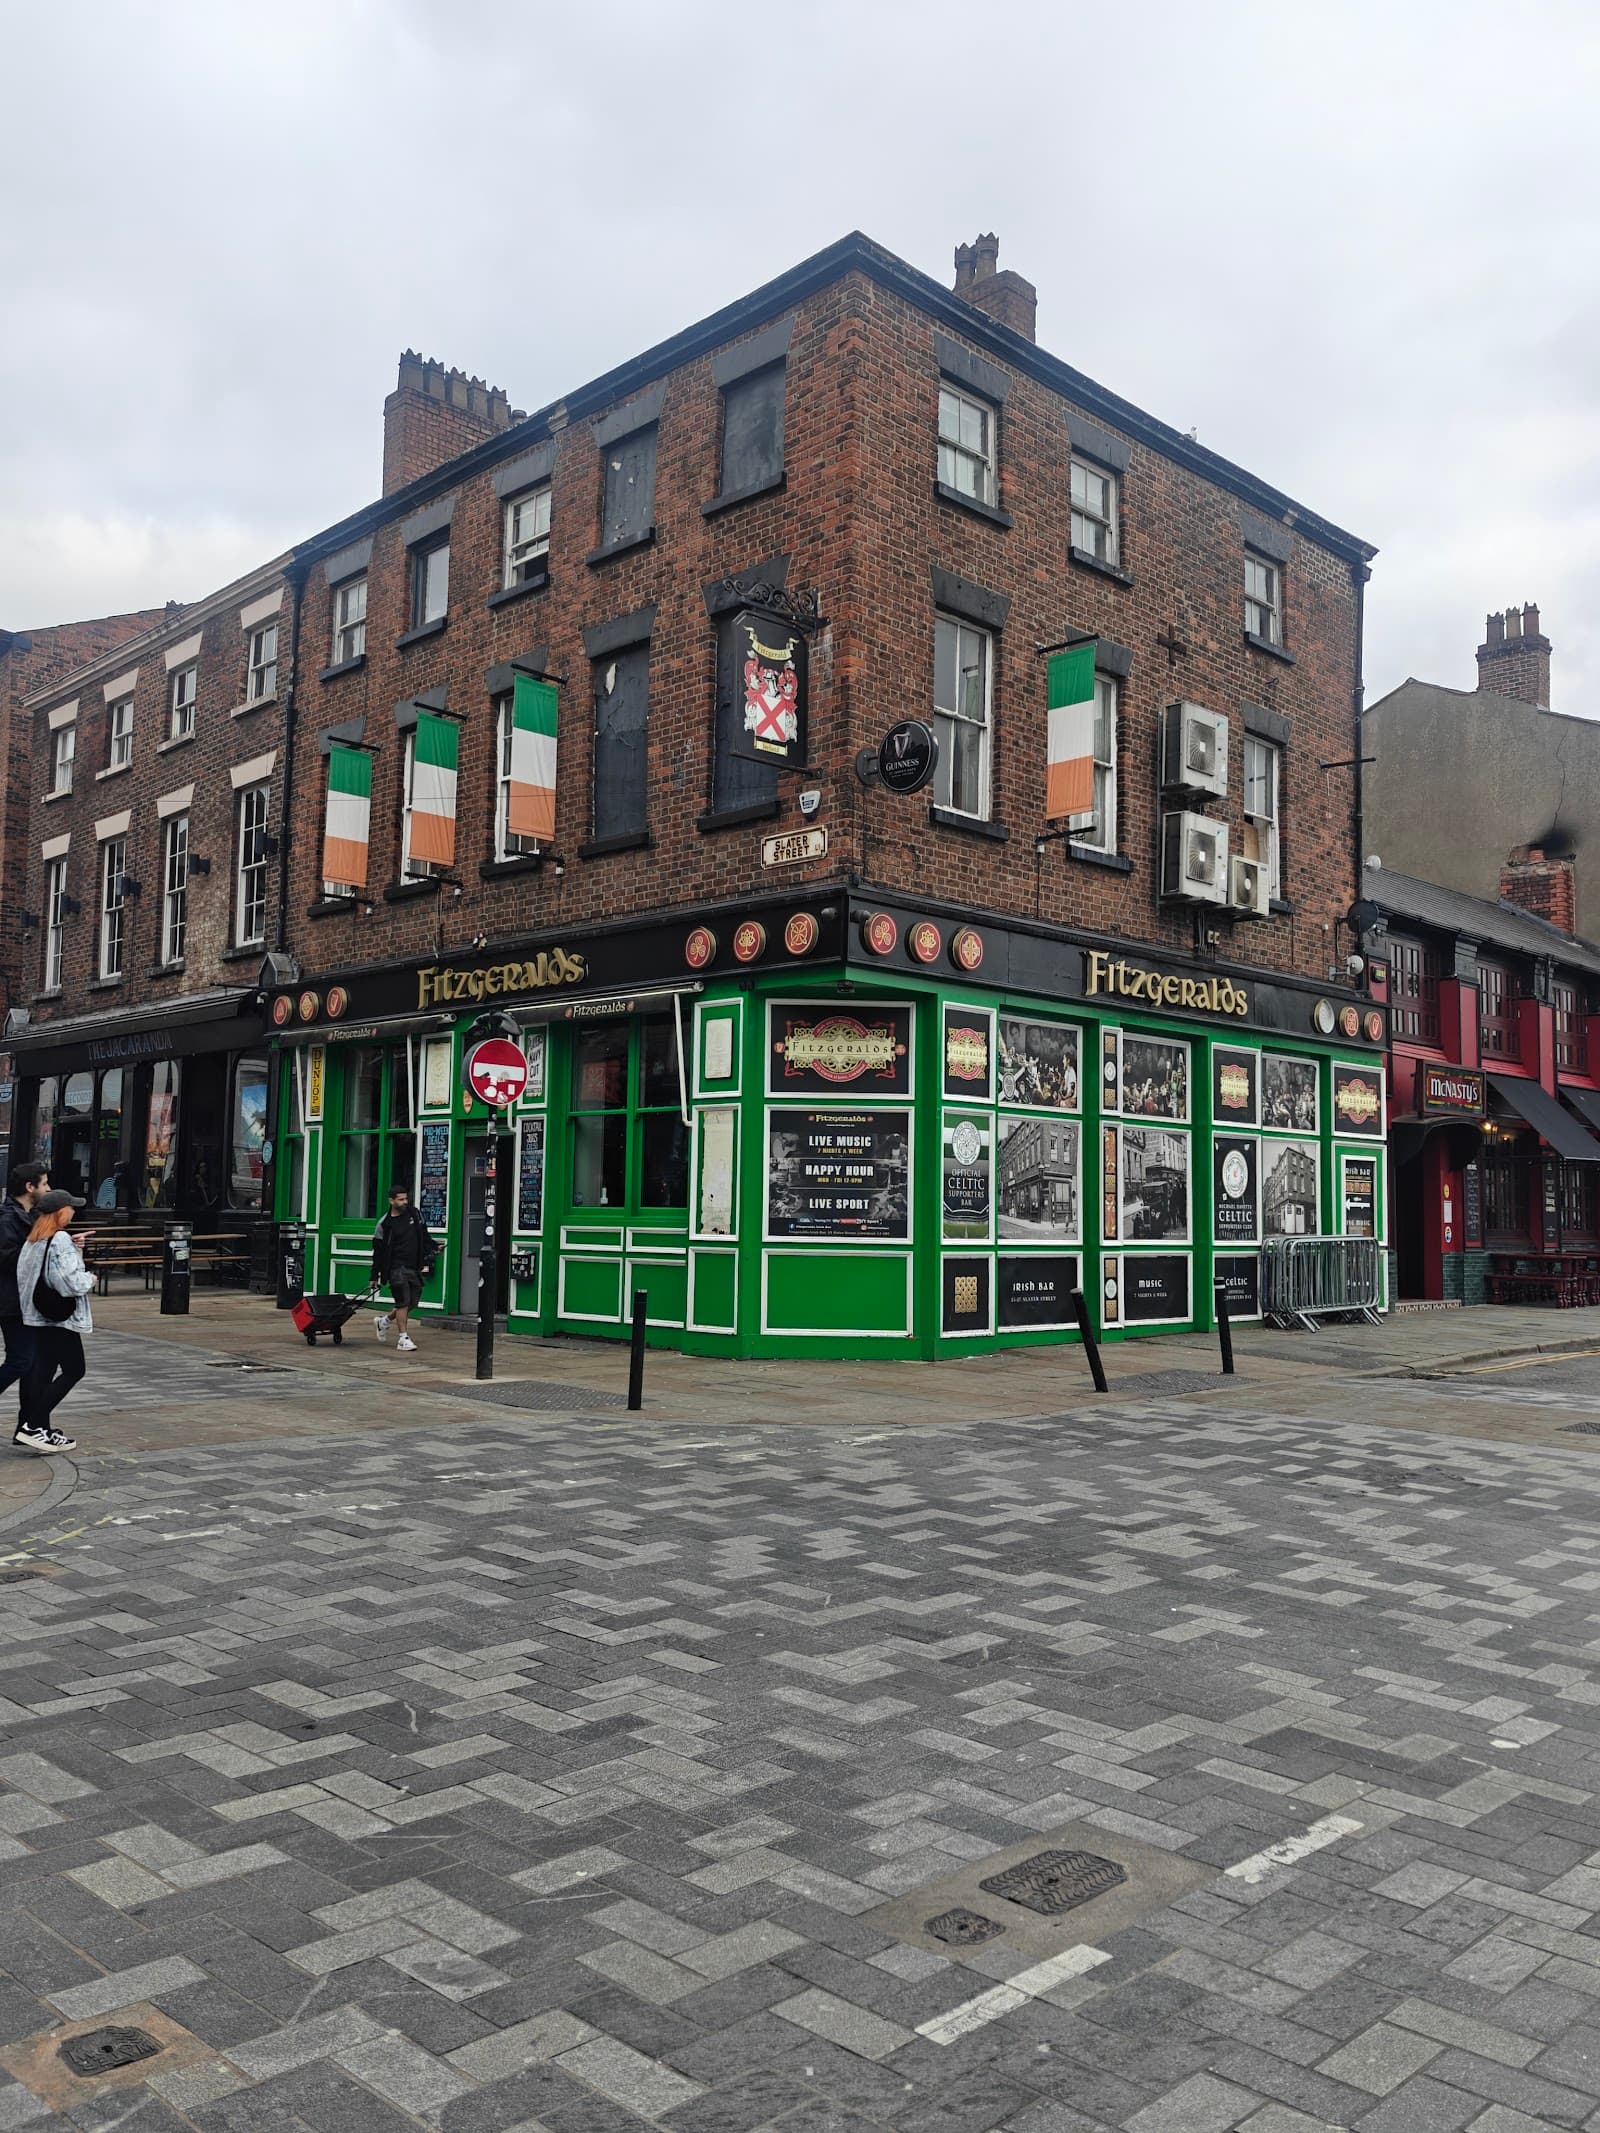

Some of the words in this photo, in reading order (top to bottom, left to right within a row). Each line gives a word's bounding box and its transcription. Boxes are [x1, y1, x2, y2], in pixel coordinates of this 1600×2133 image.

[886, 758, 920, 771] GUINNESS
[775, 836, 808, 851] SLATER
[773, 846, 809, 861] STREET
[417, 947, 585, 1010] Fitzgeralds
[1086, 951, 1248, 1015] Fitzgeralds
[573, 1001, 626, 1018] Fitzgeralds
[88, 1041, 106, 1060] THE
[108, 1030, 173, 1057] JACARANDA
[792, 1041, 889, 1054] Fitzgeralds
[312, 1048, 322, 1104] DUNLOP
[529, 1064, 540, 1079] CUT
[815, 1114, 866, 1122] Fitzgeralds
[523, 1121, 544, 1133] COCKTAIL
[427, 1135, 446, 1146] DEALS
[809, 1135, 833, 1146] LIVE
[836, 1136, 872, 1147] MUSIC
[805, 1164, 842, 1176] HAPPY
[845, 1165, 874, 1177] HOUR
[951, 1168, 981, 1178] OFFICIAL
[948, 1177, 985, 1190] CELTIC
[948, 1190, 985, 1198] SUPPORTERS
[809, 1198, 832, 1209] LIVE
[836, 1199, 870, 1209] SPORT
[1218, 1210, 1252, 1222] CELTIC
[1038, 1282, 1054, 1291] BAR
[1138, 1279, 1162, 1288] MUSIC
